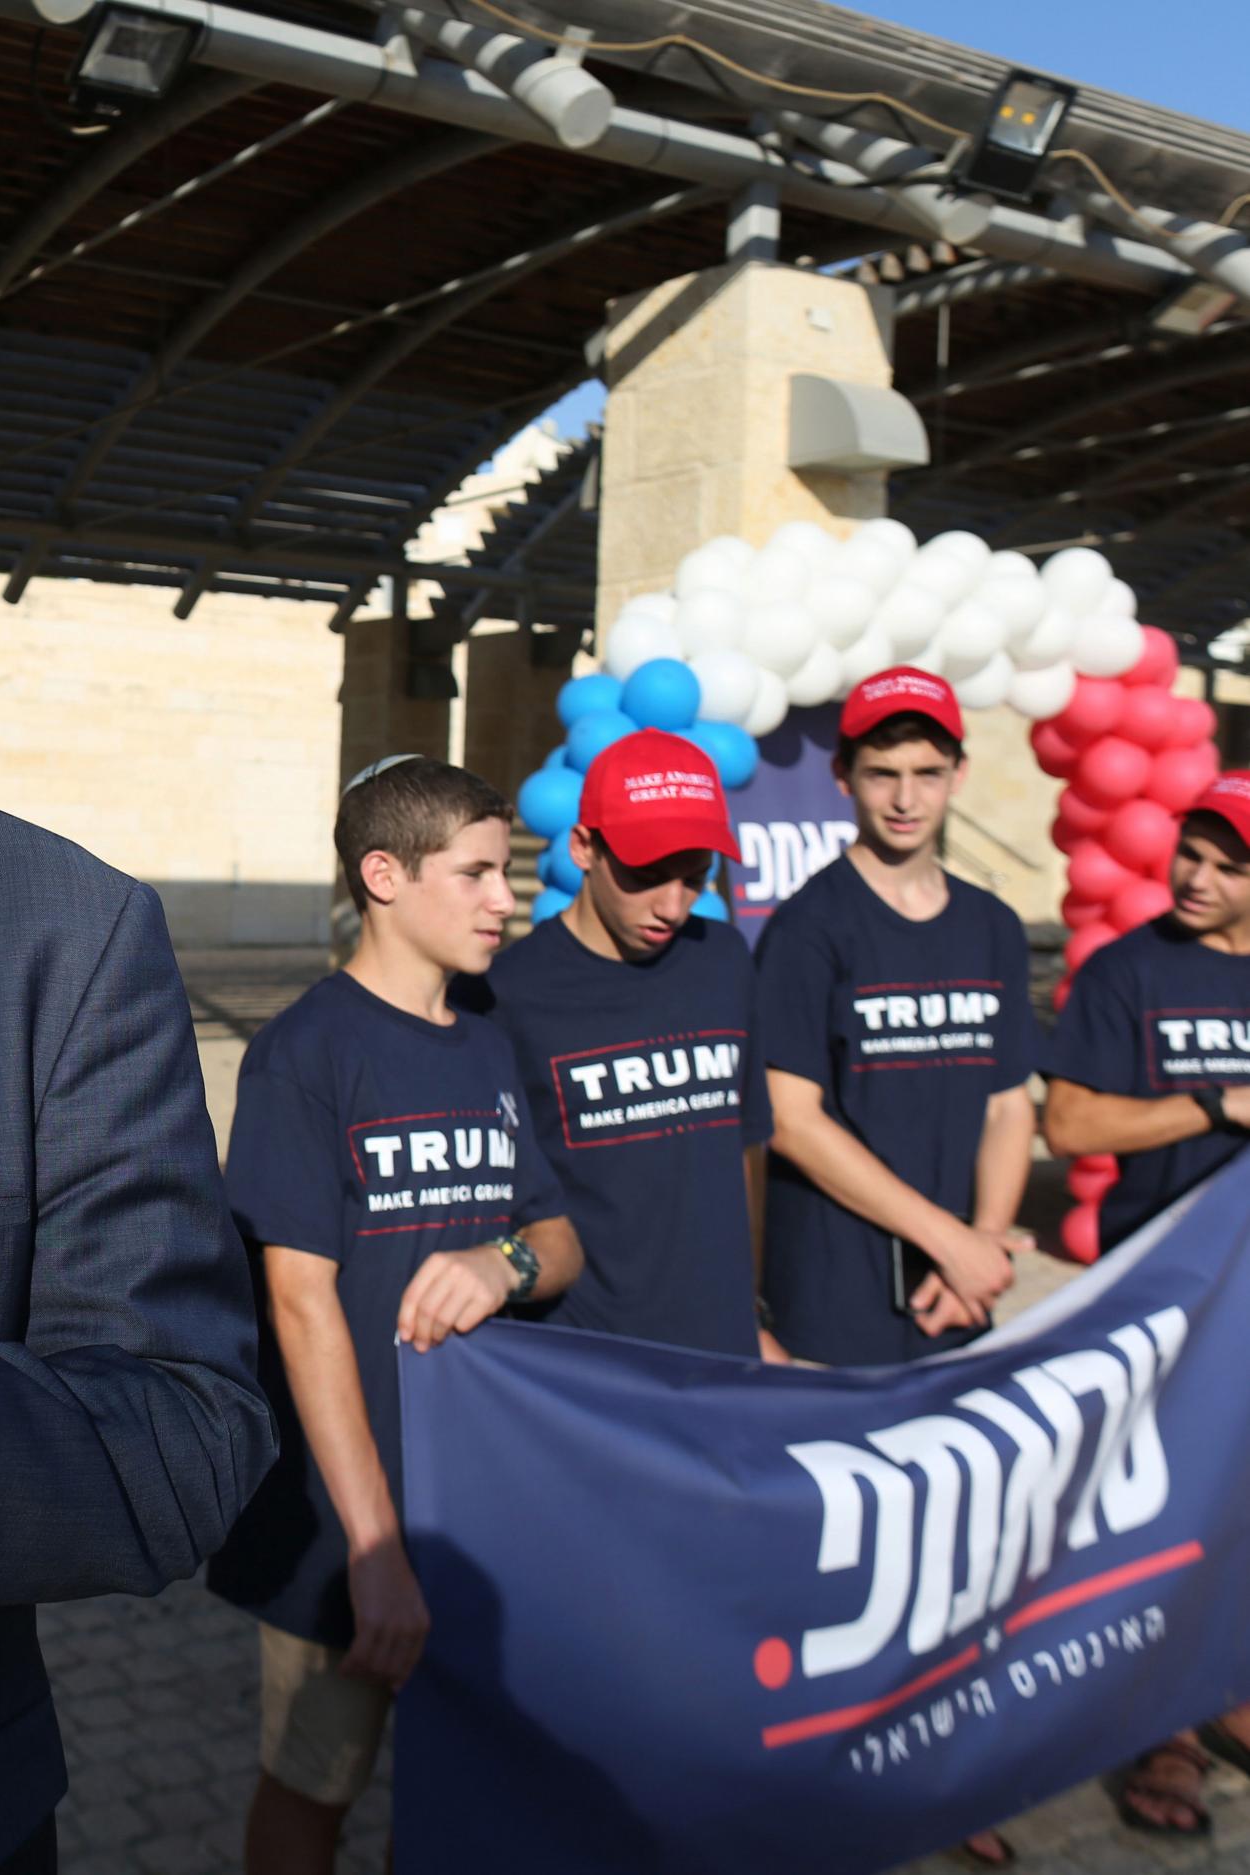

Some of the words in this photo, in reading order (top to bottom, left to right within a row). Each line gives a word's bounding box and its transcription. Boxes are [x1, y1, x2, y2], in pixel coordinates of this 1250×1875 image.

[853, 992, 1000, 1030] TRUMP
[1157, 1019, 1250, 1052] TRU
[579, 1108, 625, 1129] MAKE
[368, 1190, 414, 1212] MAKE
[1008, 1605, 1166, 1698] האינטרס
[851, 1677, 997, 1775] הישראלי
